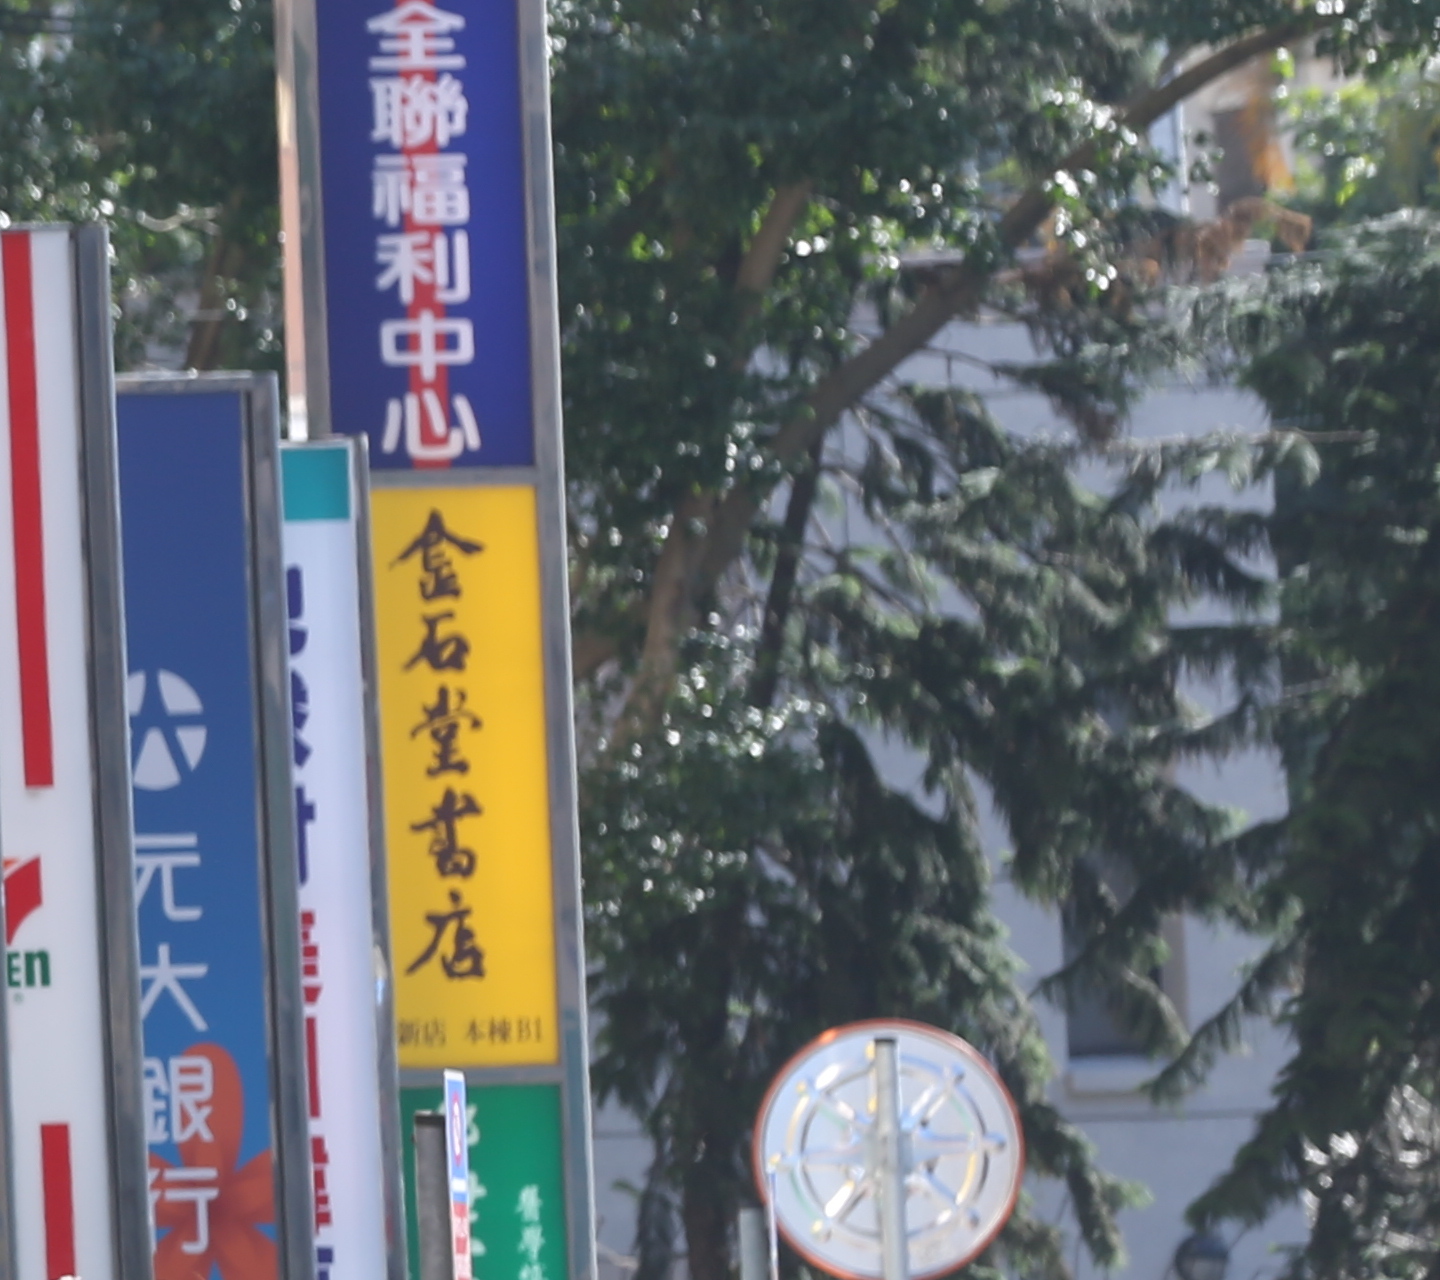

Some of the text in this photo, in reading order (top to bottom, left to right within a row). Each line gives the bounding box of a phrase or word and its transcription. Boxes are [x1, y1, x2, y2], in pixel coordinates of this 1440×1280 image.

[366, 0, 481, 461] 全聯福利中心
[388, 508, 485, 982] 金石堂書店
[133, 832, 219, 1255] 元大銀行
